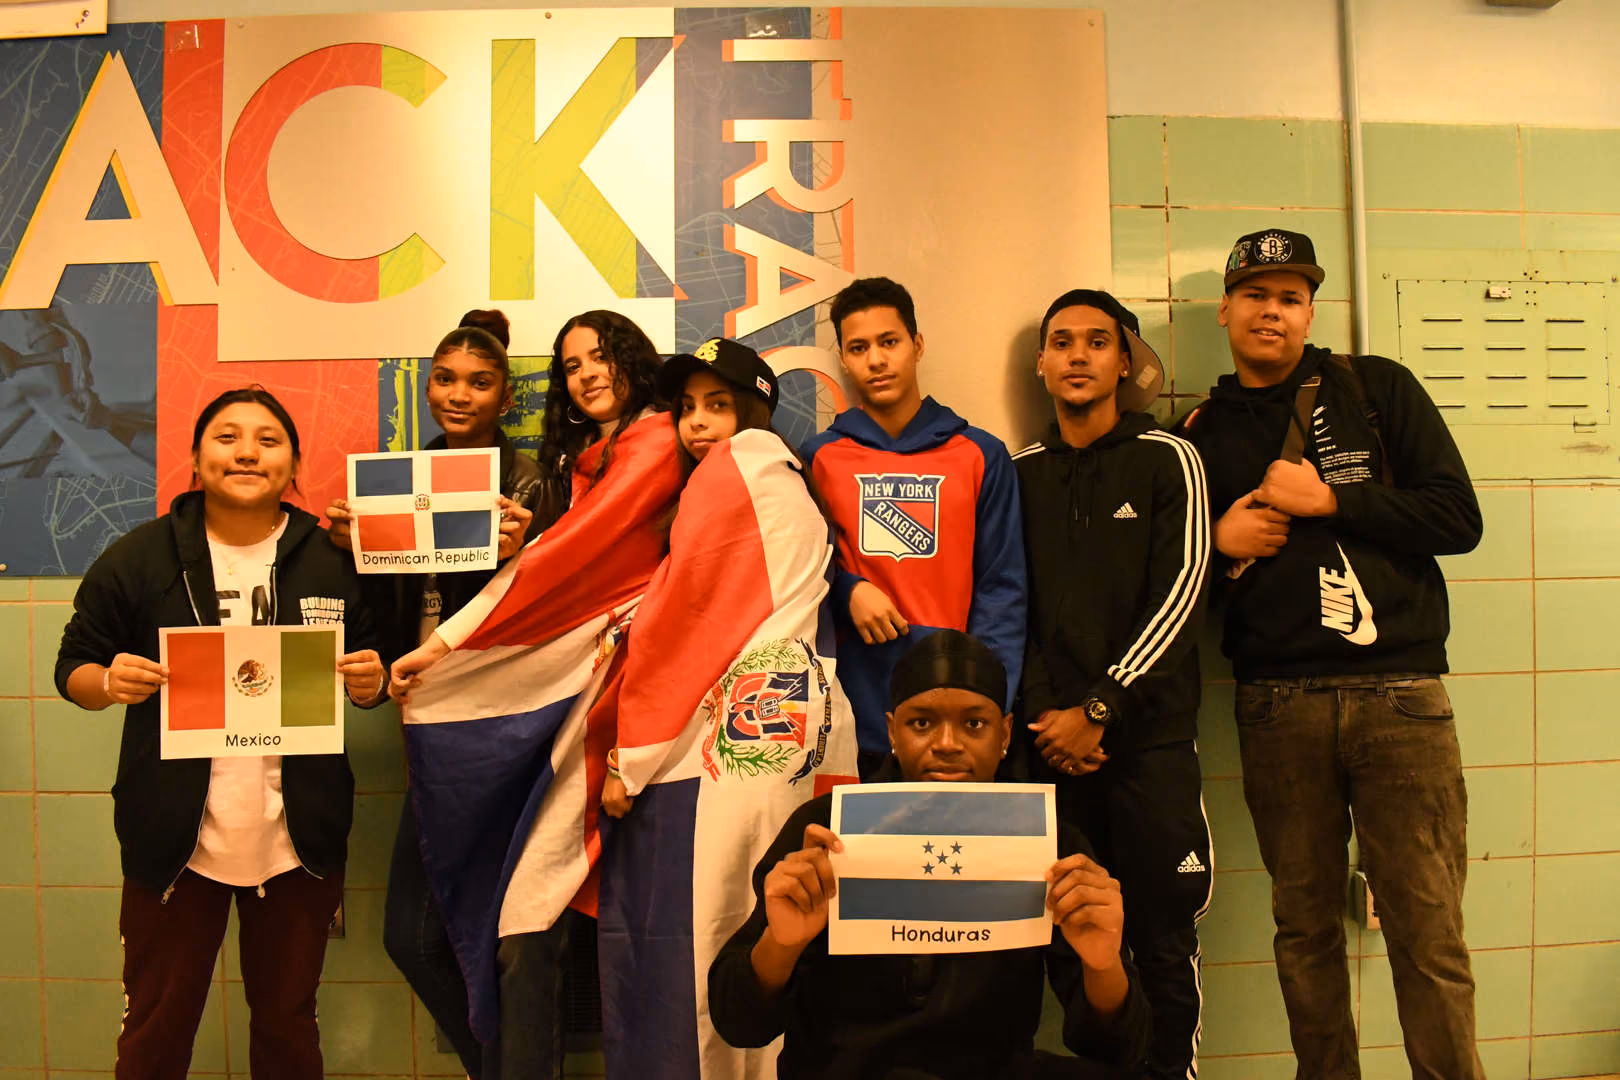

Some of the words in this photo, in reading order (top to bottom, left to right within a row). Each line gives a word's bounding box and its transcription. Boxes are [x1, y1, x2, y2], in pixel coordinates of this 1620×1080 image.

[864, 483, 894, 497] NEW
[898, 483, 934, 498] YORK
[1113, 511, 1138, 519] adidas
[873, 501, 931, 551] RANGERS
[362, 553, 430, 565] Dominican
[434, 549, 490, 564] Republic
[1319, 566, 1354, 633] NIKE
[225, 732, 282, 747] Mexico
[1177, 863, 1206, 873] adidas
[891, 924, 991, 943] Honduras
